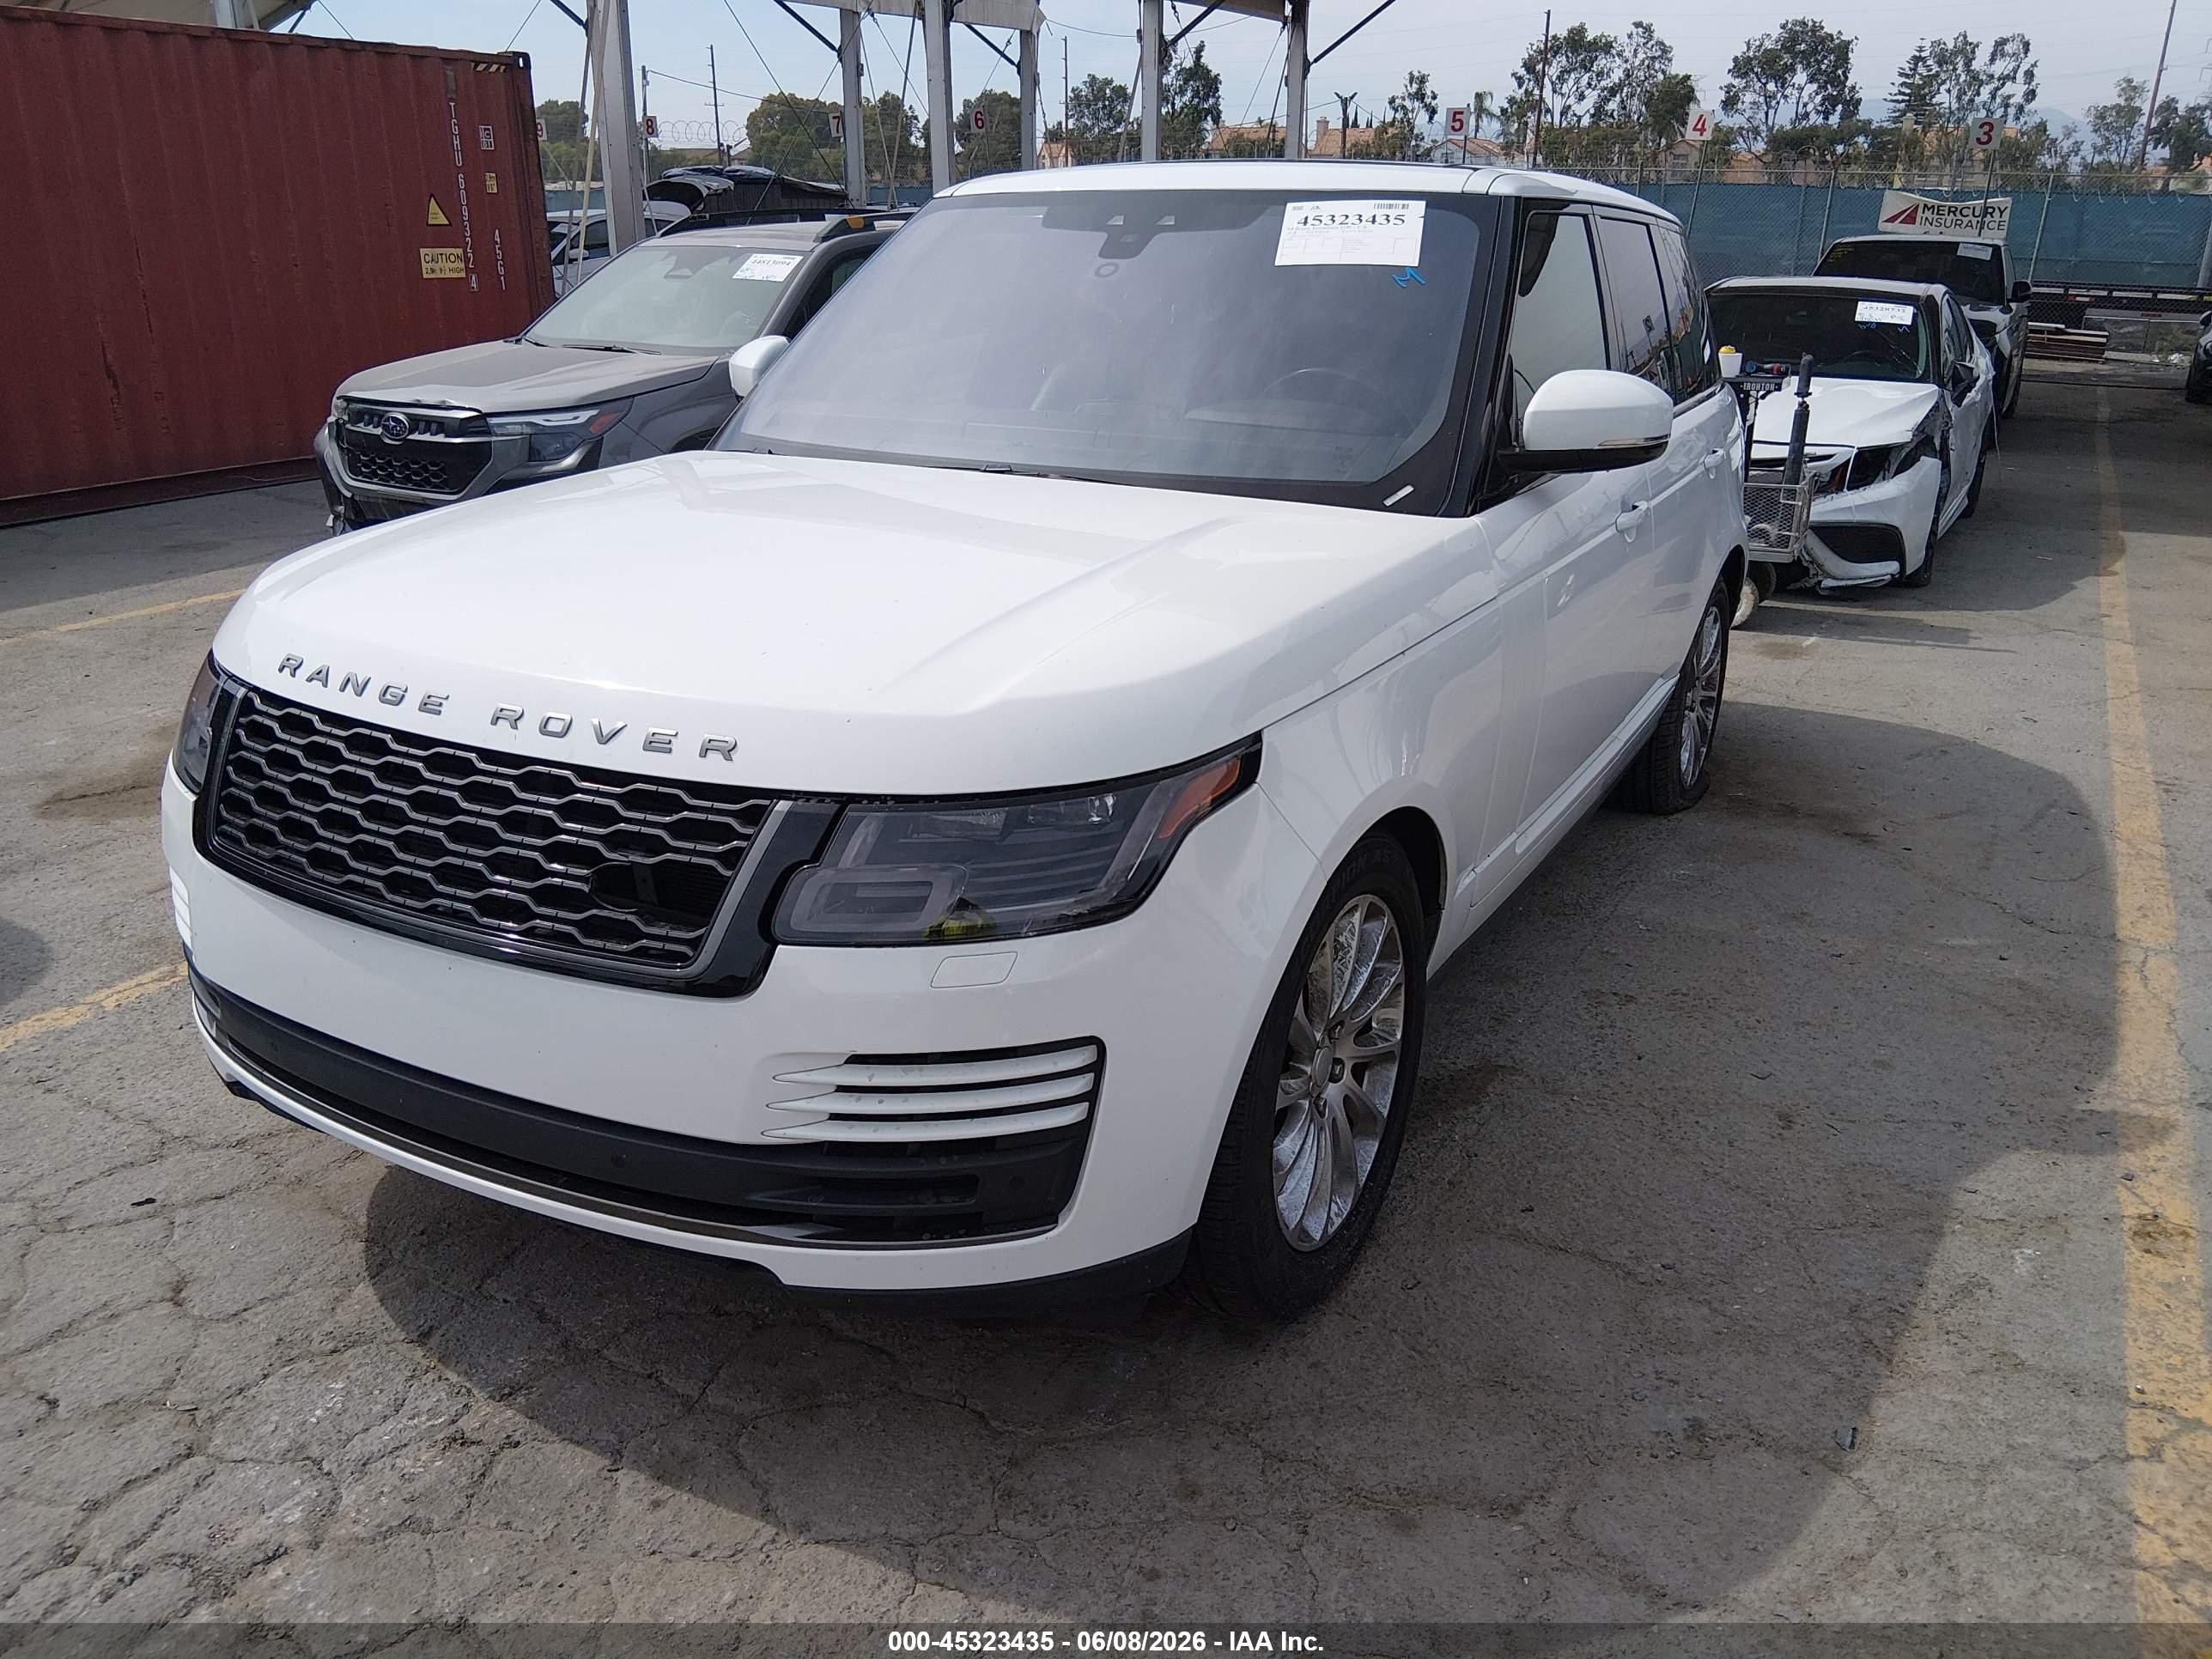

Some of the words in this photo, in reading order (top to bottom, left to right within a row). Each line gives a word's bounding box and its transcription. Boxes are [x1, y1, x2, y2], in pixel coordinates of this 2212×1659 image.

[536, 122, 543, 137] 9
[646, 118, 655, 135] 8
[832, 116, 841, 134] 7
[975, 111, 985, 129] 6
[1450, 111, 1464, 132] 5
[1692, 114, 1707, 137] 4
[449, 102, 463, 167] TGHU
[1976, 121, 1995, 146] 3
[458, 173, 475, 268] 609322
[1297, 213, 1407, 227] 45323435
[1921, 203, 2008, 219] MERCURY
[1919, 216, 2007, 231] INSURANCE
[423, 253, 463, 264] CAUTION
[494, 228, 506, 290] 45G1
[277, 653, 449, 715] RANGE
[489, 702, 738, 763] ROVER
